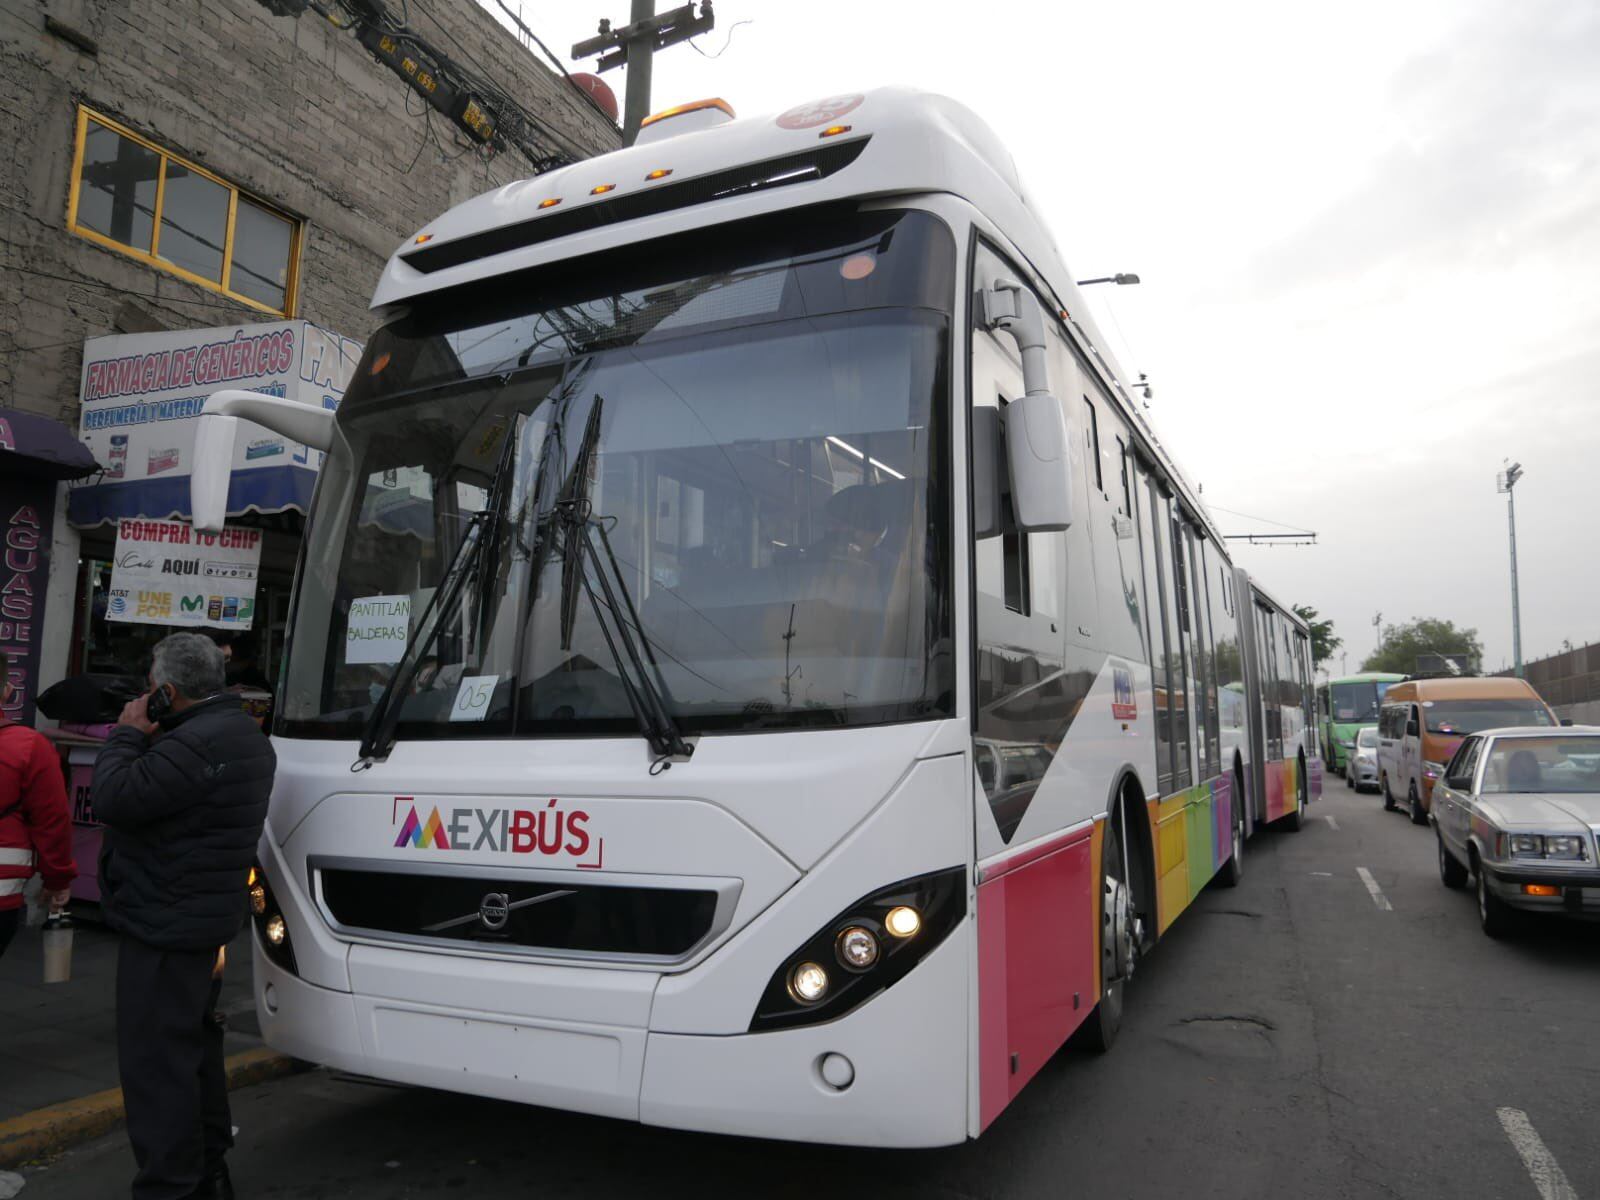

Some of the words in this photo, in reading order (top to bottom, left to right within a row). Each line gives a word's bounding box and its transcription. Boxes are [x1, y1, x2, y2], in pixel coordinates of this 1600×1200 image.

[85, 352, 172, 400] FARMACIA
[167, 346, 197, 390] DE
[194, 329, 295, 385] GENÉRICOS
[84, 399, 148, 431] PERFUMERÍA
[149, 402, 159, 423] Y
[120, 520, 190, 544] COMPRA
[219, 528, 260, 549] CHIP
[1, 505, 40, 620] AGUAS
[161, 558, 200, 576] AQUÍ
[110, 589, 129, 598] AT&T
[138, 591, 173, 604] UNE
[136, 605, 171, 618] FON
[350, 601, 410, 617] PANTITLAN
[348, 626, 406, 641] BALDERAS
[458, 683, 492, 711] 05
[394, 799, 590, 856] MEXIBÚS
